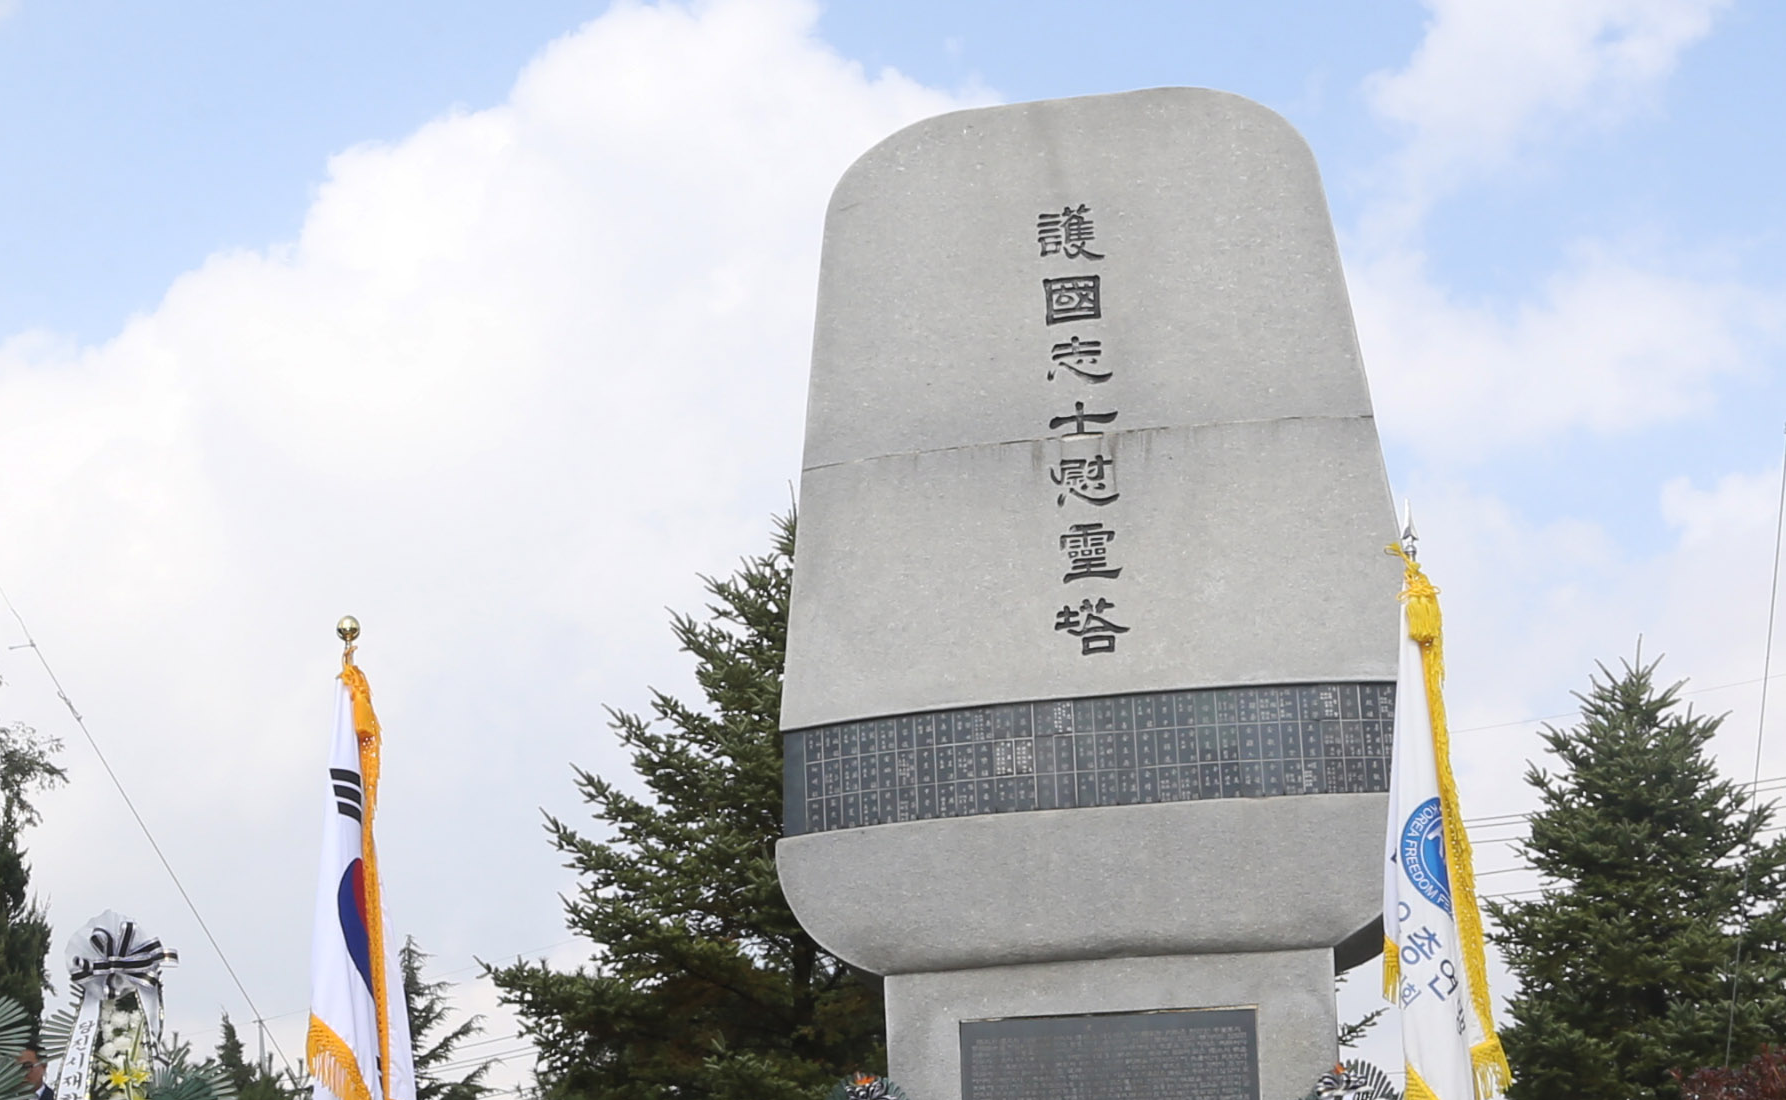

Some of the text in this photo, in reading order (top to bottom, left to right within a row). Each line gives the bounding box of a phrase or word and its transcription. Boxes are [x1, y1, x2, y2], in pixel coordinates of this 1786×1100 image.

[1036, 203, 1131, 656] 護國志士慰靈塔
[1406, 803, 1439, 839] KOREA
[1404, 839, 1439, 900] FREEDOM
